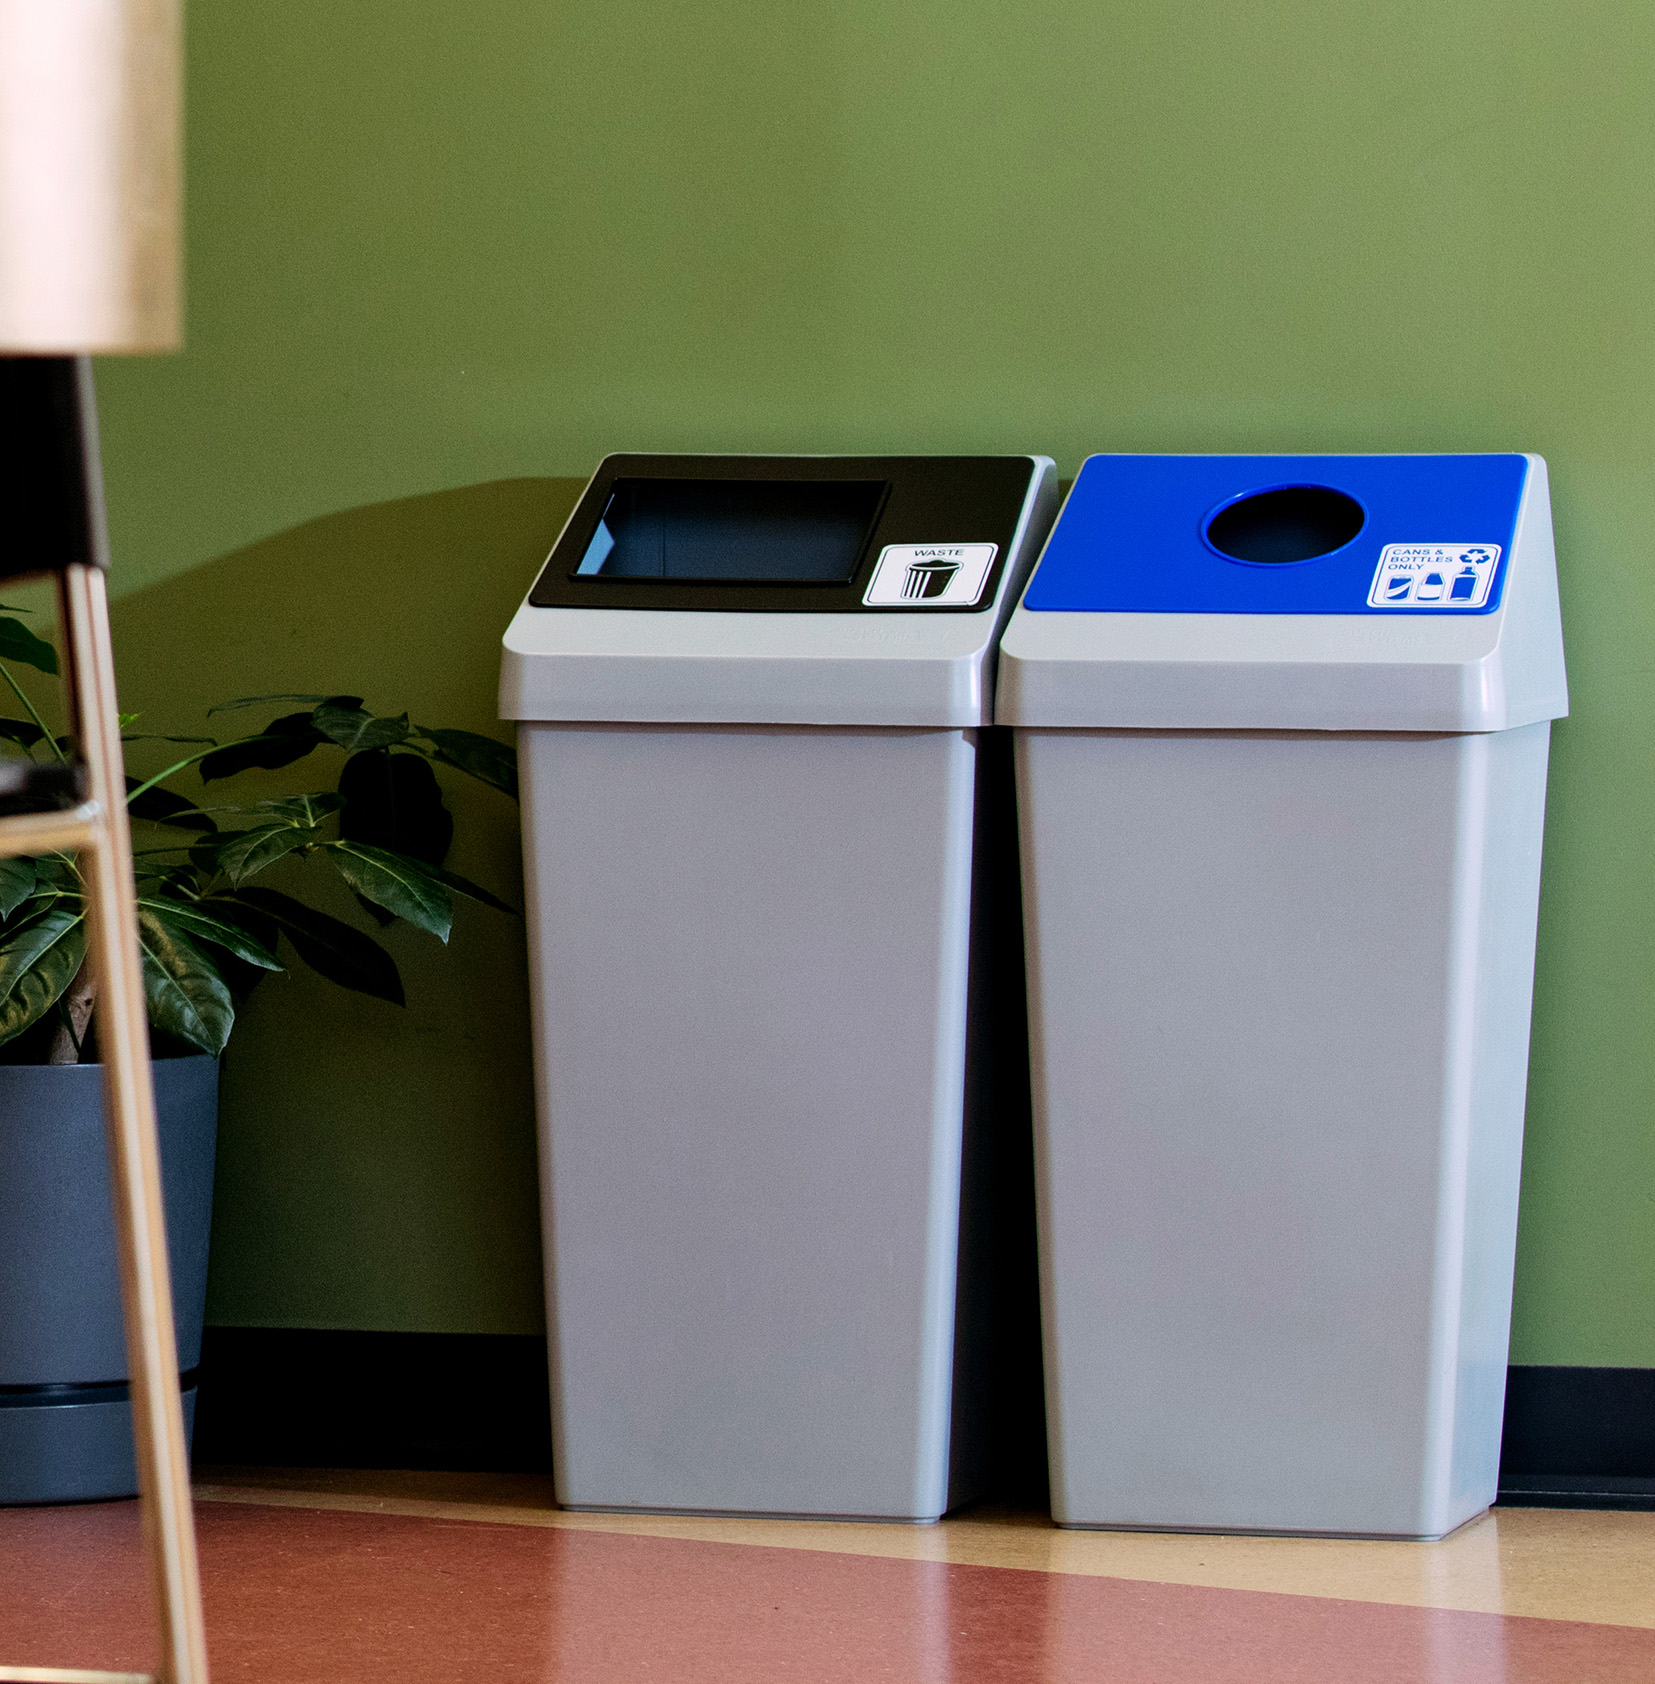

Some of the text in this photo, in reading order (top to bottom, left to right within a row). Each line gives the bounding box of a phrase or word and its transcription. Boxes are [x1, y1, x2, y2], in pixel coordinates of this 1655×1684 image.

[914, 548, 965, 557] WASTE
[1392, 548, 1444, 556] CANS &
[1388, 563, 1424, 571] ONLY
